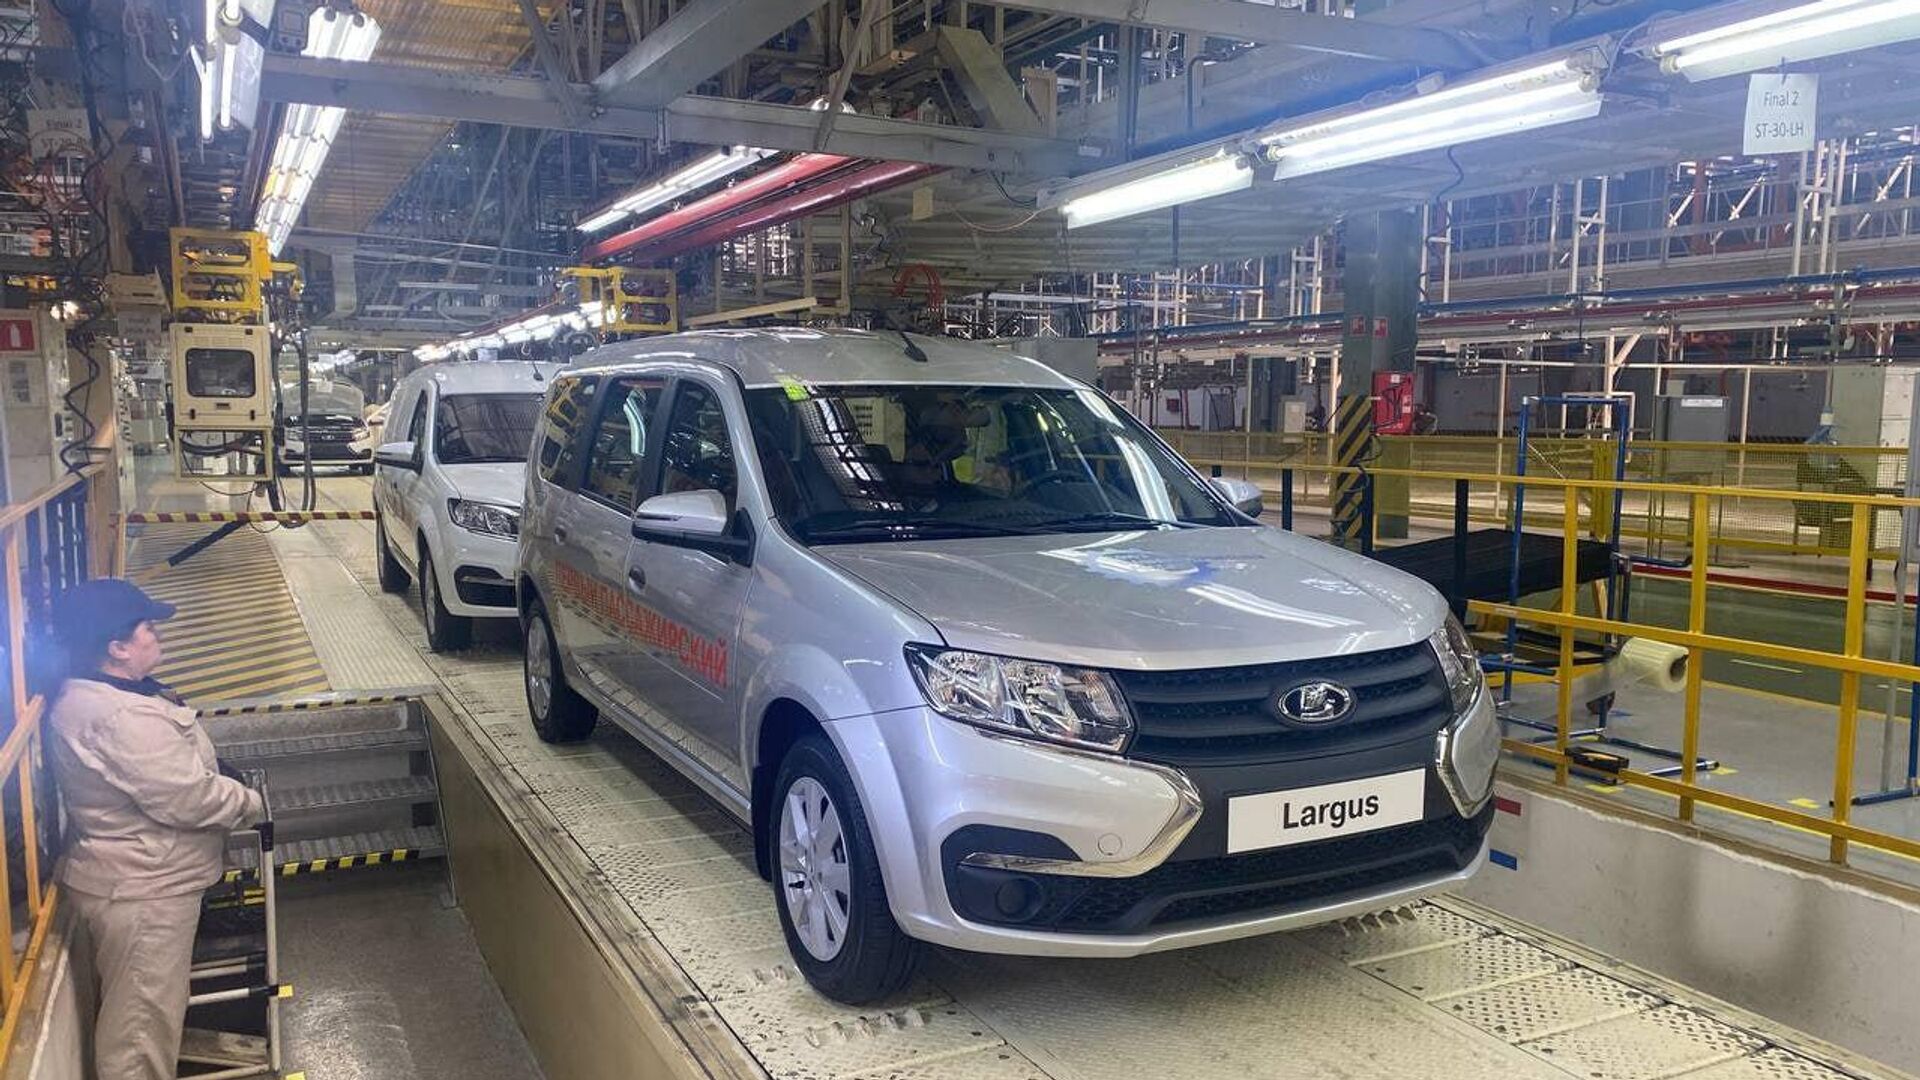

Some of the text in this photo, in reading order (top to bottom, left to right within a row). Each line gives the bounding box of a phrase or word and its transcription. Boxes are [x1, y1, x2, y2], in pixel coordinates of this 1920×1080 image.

[1763, 90, 1800, 106] Final 2
[1755, 121, 1804, 139] ST-30-LH
[1282, 794, 1380, 829] Largus
